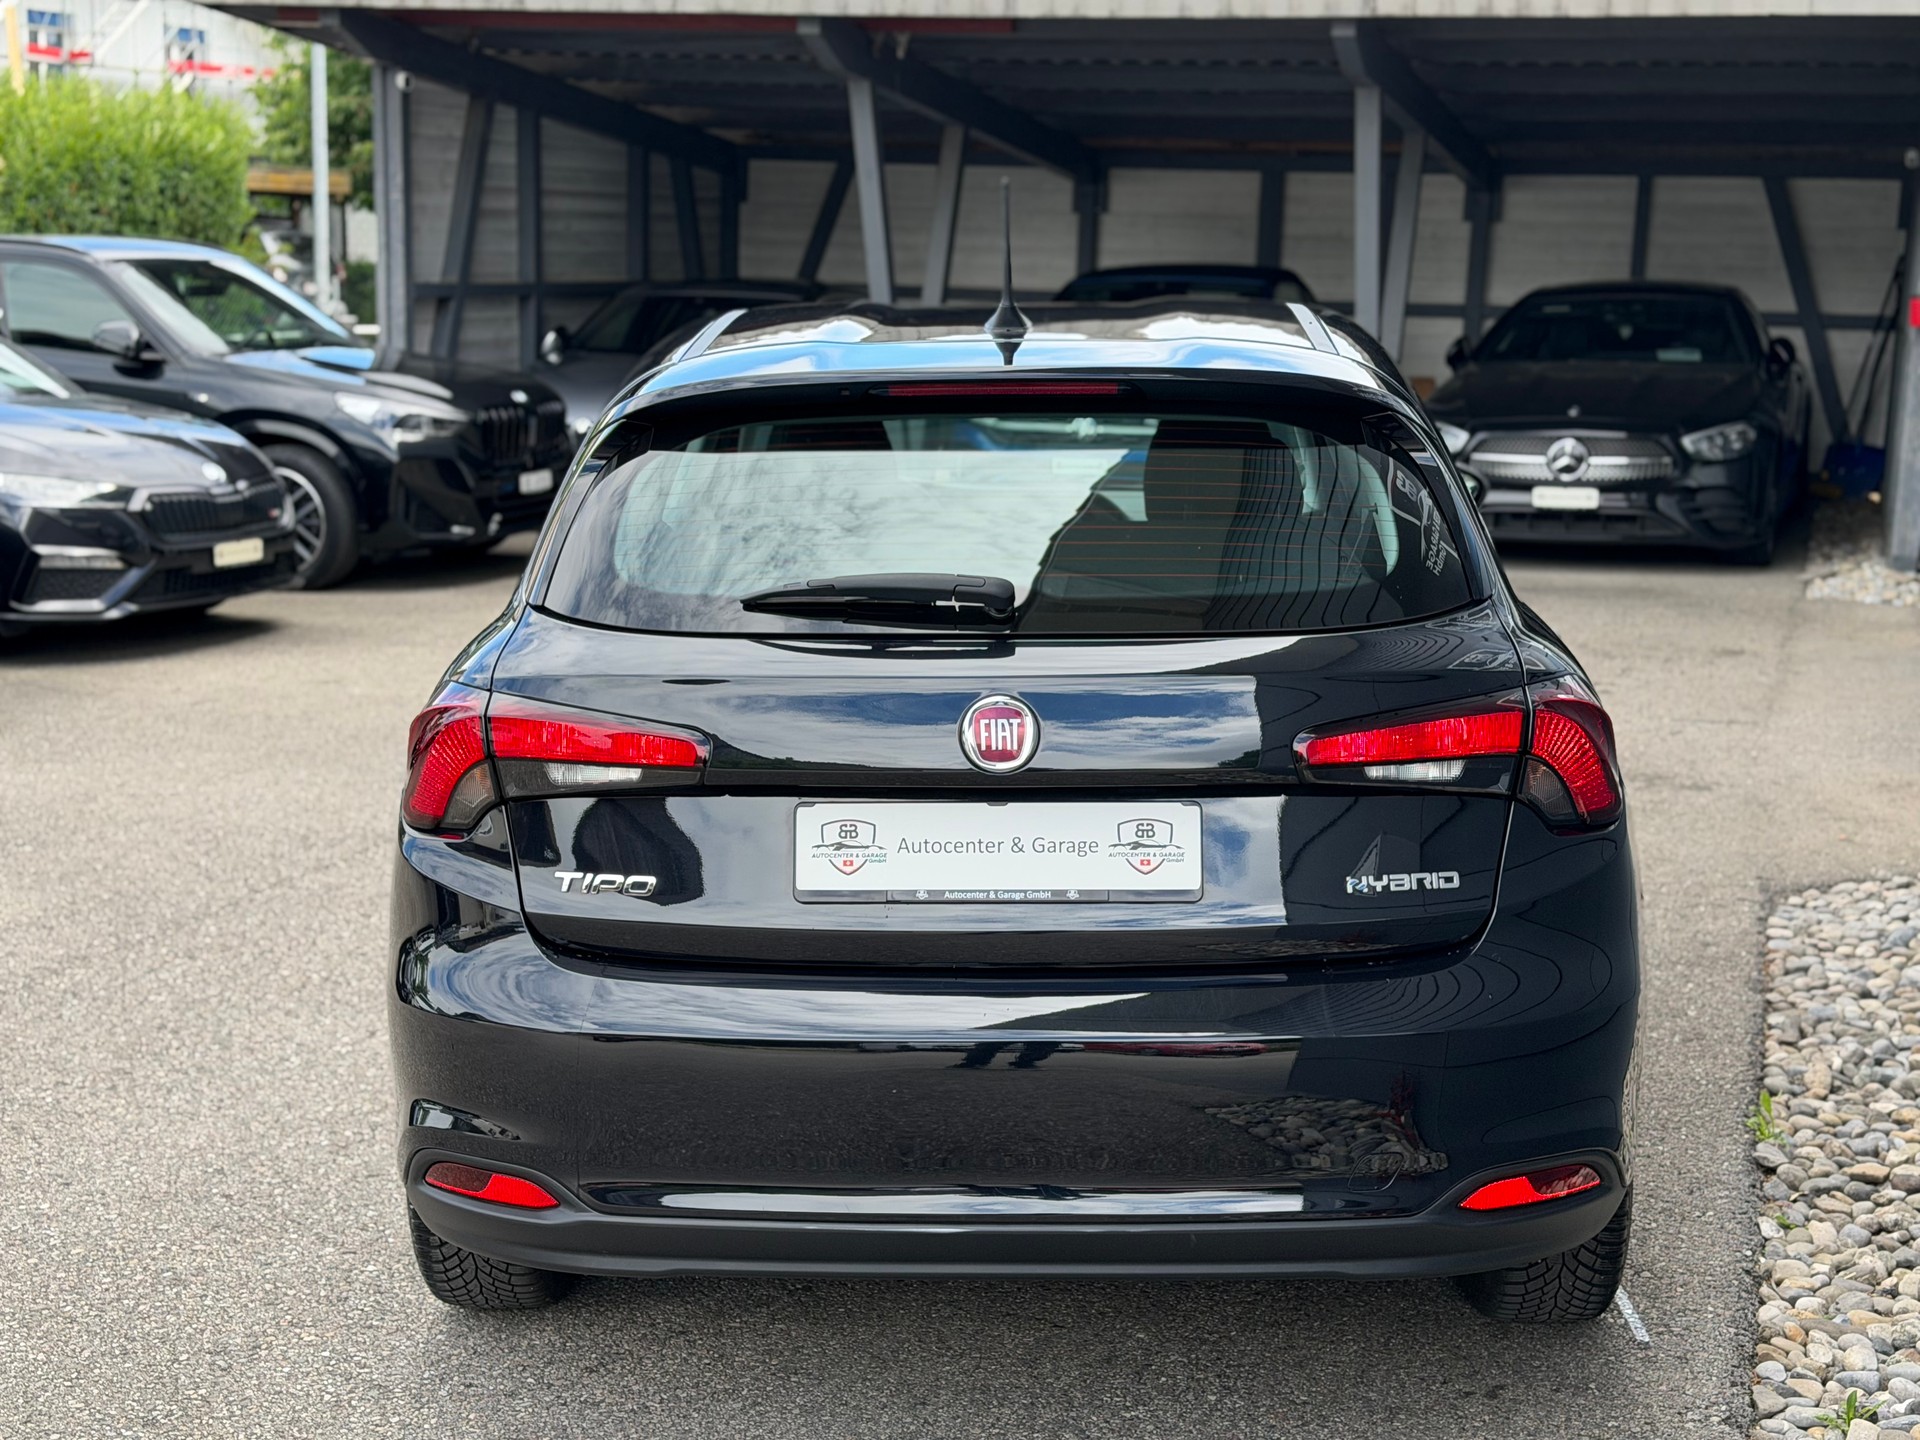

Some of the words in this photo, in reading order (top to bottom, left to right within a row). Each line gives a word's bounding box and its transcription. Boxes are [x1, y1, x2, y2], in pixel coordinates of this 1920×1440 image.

[979, 718, 1022, 751] FIAT
[896, 837, 1005, 854] Autocenter
[1010, 836, 1026, 854] &
[1032, 836, 1100, 858] Garage
[554, 870, 658, 897] TIPO
[1345, 870, 1461, 895] HYBRID
[943, 890, 987, 900] Autocenter
[988, 890, 996, 900] &
[997, 890, 1025, 901] Garage
[1026, 890, 1052, 900] GmbH
